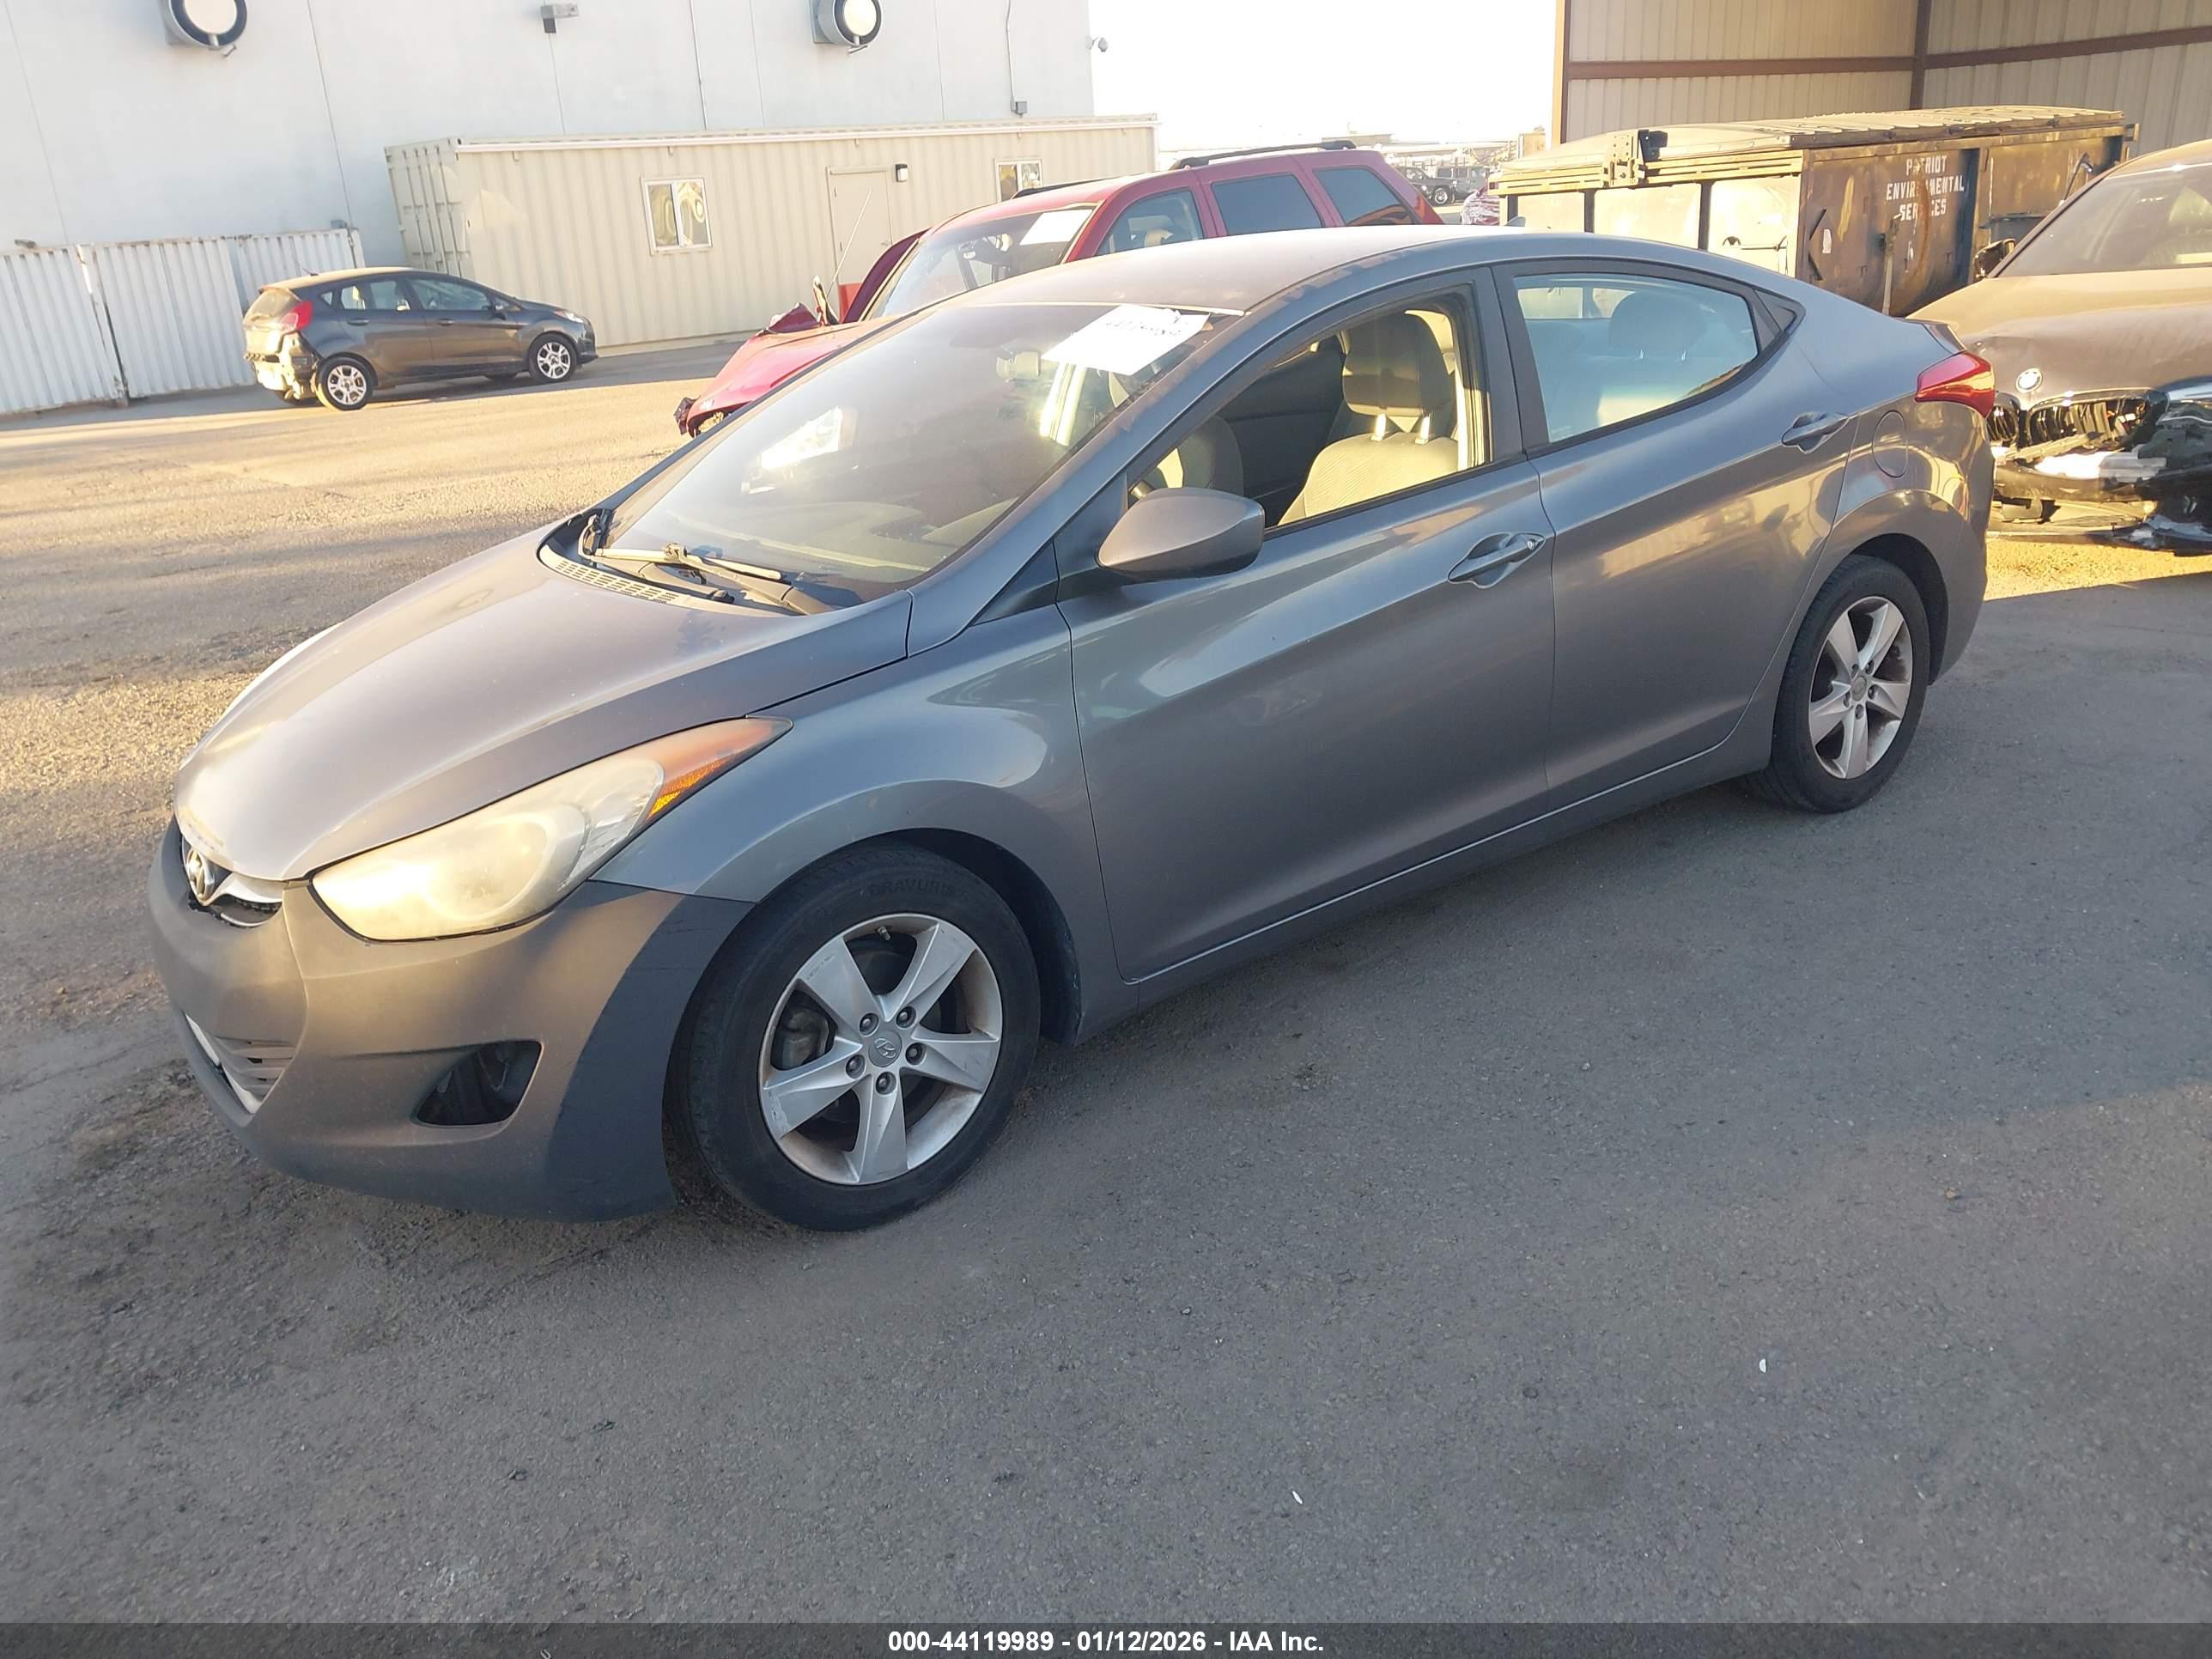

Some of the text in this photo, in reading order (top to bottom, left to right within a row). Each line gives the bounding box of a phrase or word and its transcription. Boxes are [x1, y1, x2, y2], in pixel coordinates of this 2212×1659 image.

[1906, 155, 1948, 175] PATRIOT
[1886, 174, 1965, 200] ENVIRMENTAL
[1899, 198, 1947, 221] SERES
